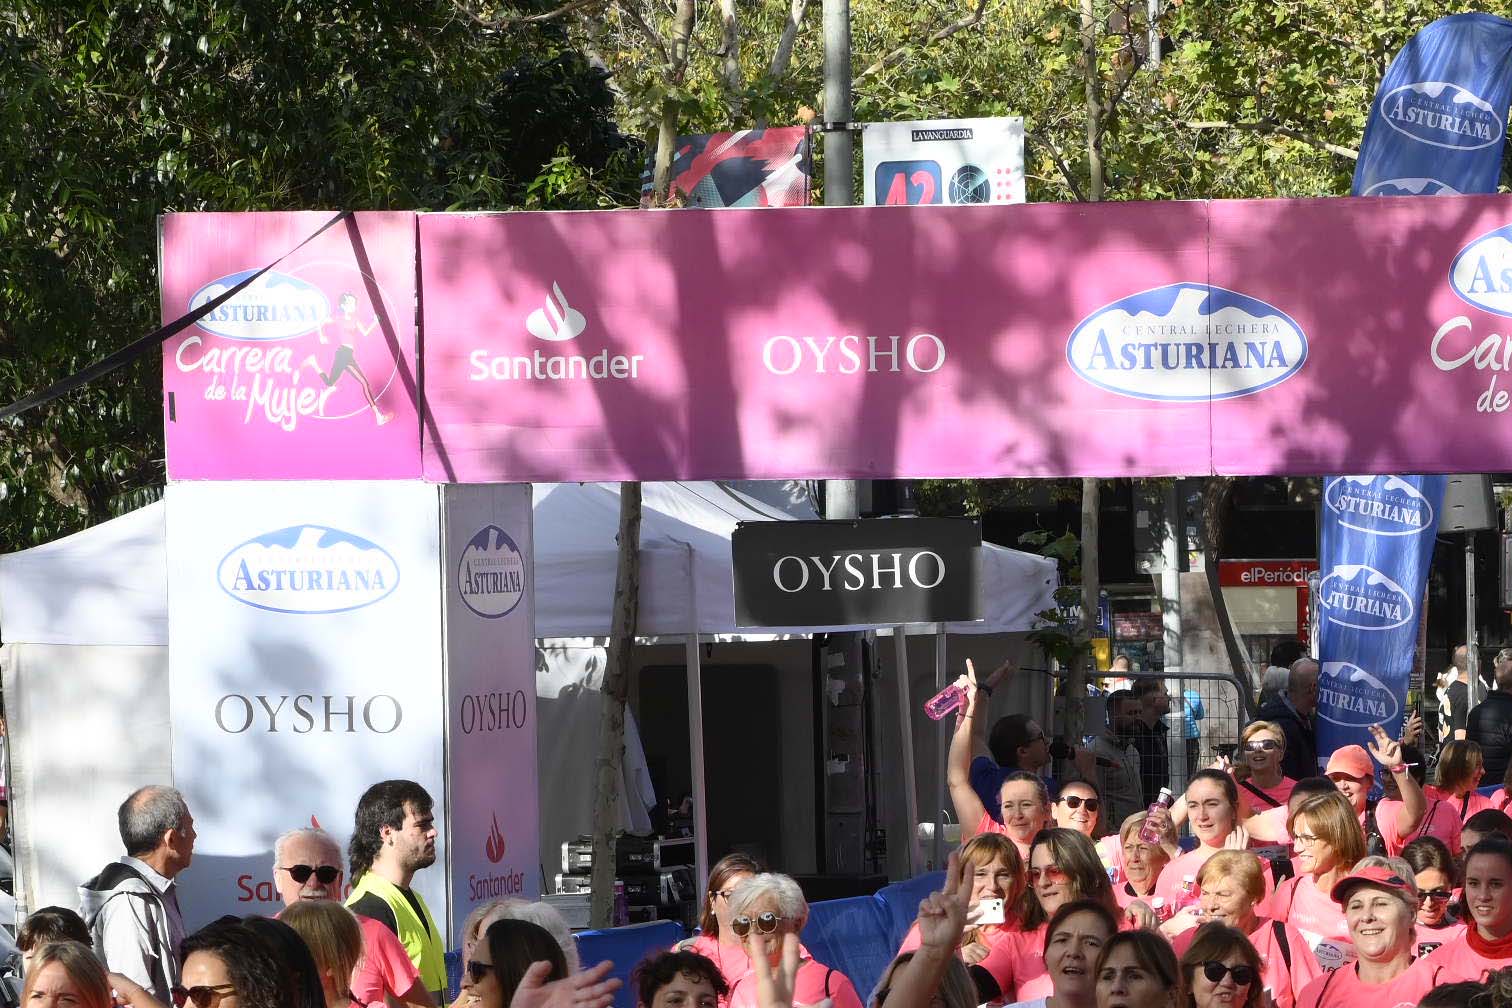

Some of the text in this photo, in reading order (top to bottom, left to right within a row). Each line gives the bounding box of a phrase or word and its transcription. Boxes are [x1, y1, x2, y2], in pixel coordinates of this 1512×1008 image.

[1389, 95, 1492, 140] ASTURIANA
[1086, 327, 1289, 371] ASTURIANA
[1122, 322, 1280, 336] CENTRAL LECHERA
[175, 335, 293, 374] Carrera
[470, 349, 644, 382] Santander
[762, 333, 947, 376] OYSHO
[204, 366, 337, 432] de la Mujer
[1476, 374, 1511, 413] de
[232, 558, 386, 592] ASTURIANA
[463, 559, 521, 595] ASTURIANA
[773, 551, 946, 593] OYSHO
[214, 693, 403, 734] OYSHO
[461, 689, 526, 735] OYSHO
[469, 871, 525, 902] Santander
